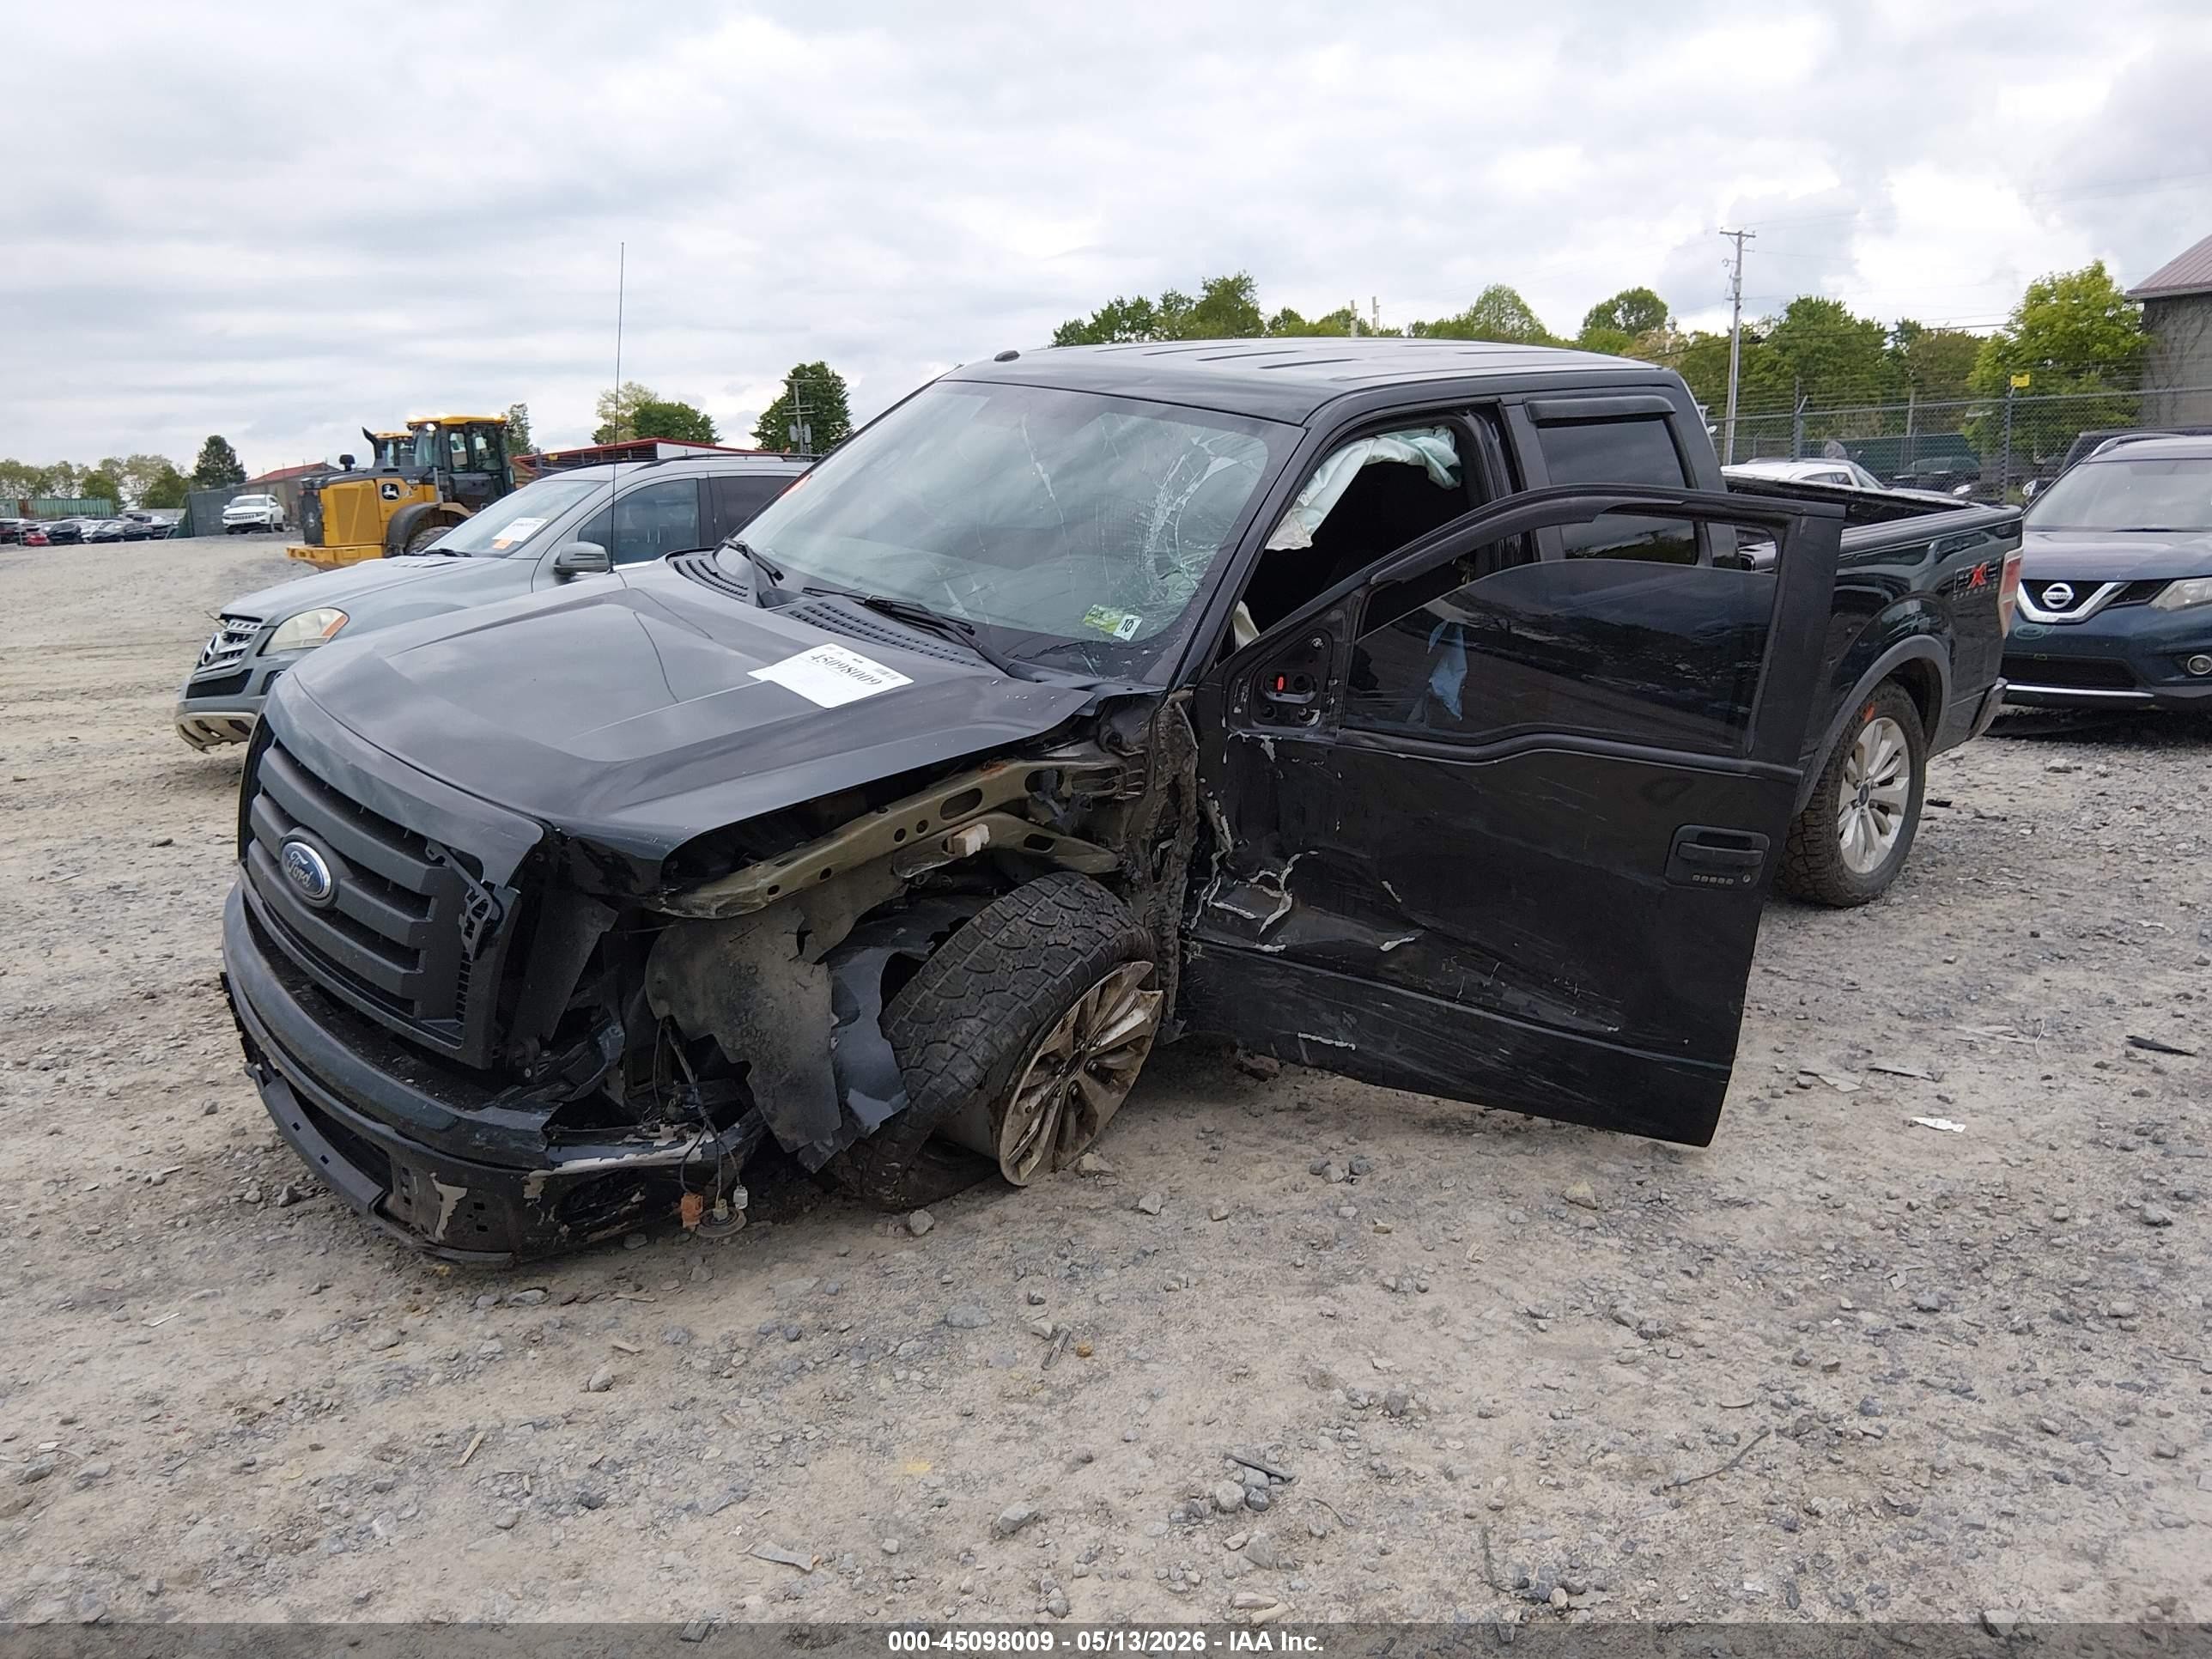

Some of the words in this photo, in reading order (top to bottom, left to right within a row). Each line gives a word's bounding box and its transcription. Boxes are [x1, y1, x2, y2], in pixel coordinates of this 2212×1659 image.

[1121, 618, 1134, 633] 10
[810, 654, 883, 685] 45098009
[288, 850, 313, 887] Ford
